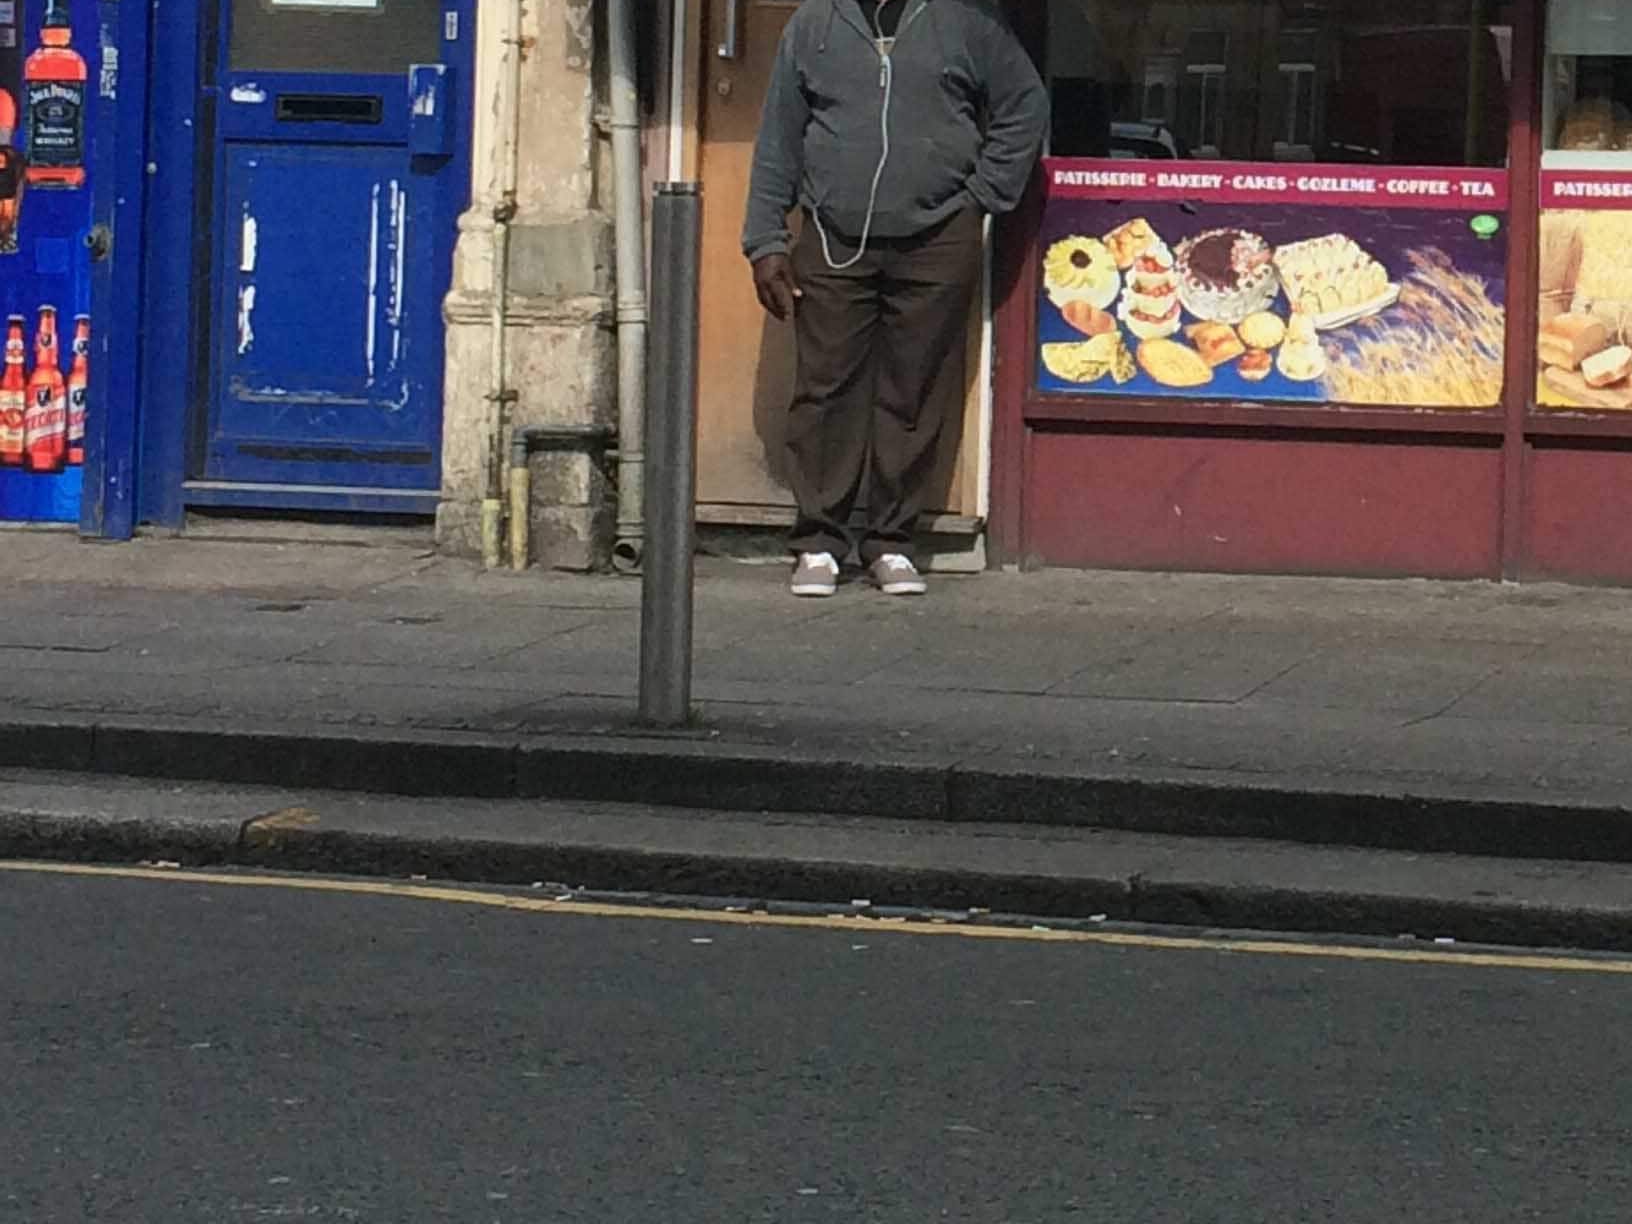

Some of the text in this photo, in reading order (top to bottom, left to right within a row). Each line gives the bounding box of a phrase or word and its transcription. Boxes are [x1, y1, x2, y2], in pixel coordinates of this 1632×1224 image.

[1054, 170, 1147, 187] PATISSERIE
[1157, 173, 1223, 188] BAKERY
[1232, 174, 1287, 191] CAKES
[1386, 179, 1449, 195] COFFEE
[1460, 181, 1495, 196] TEA
